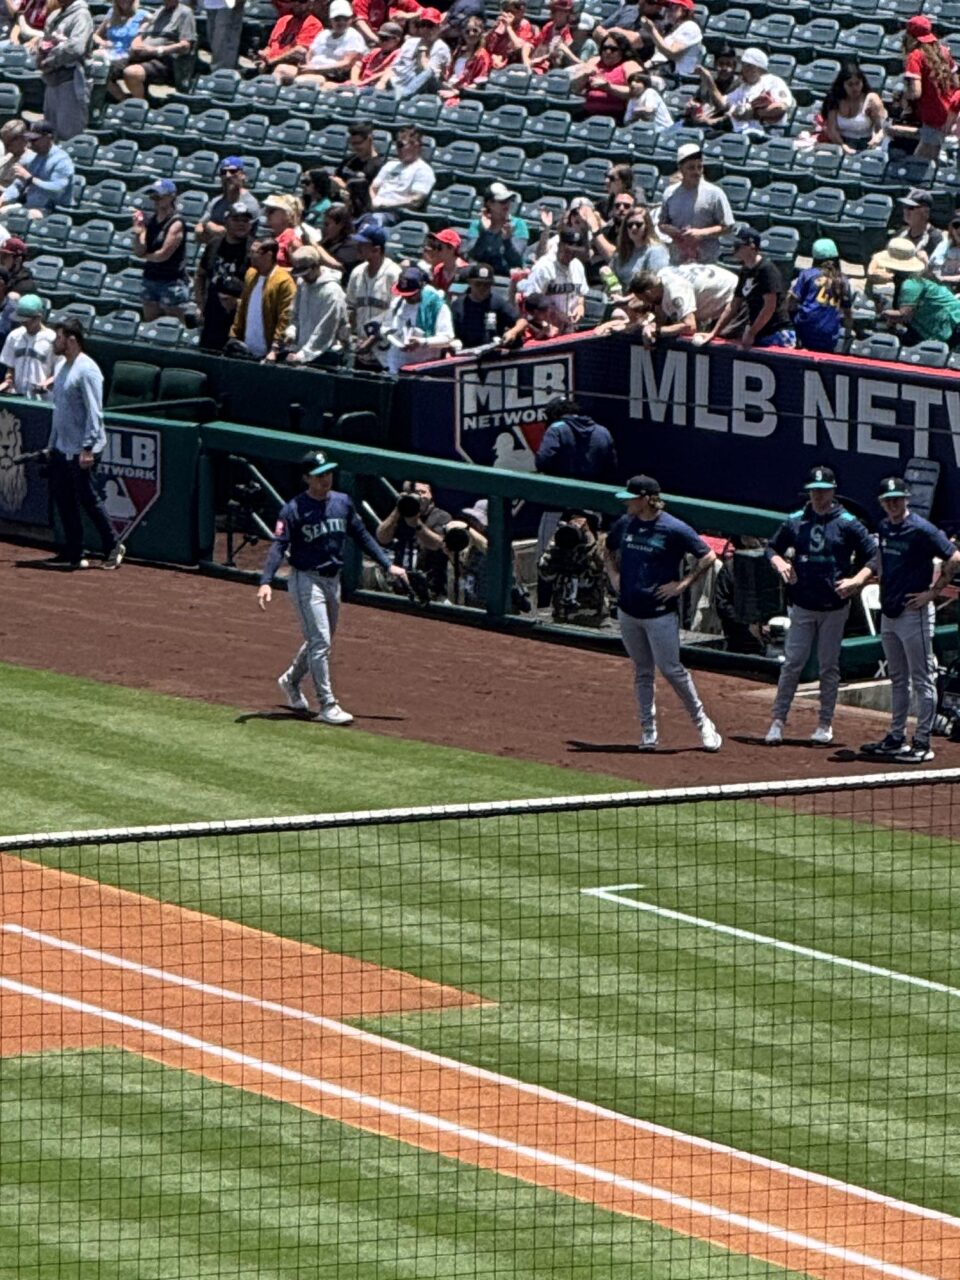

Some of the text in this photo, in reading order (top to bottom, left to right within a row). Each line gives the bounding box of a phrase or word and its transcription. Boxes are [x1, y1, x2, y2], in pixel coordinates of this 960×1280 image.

[462, 363, 566, 414] MLB
[631, 345, 960, 468] MLB NET
[463, 408, 548, 431] NETWOR
